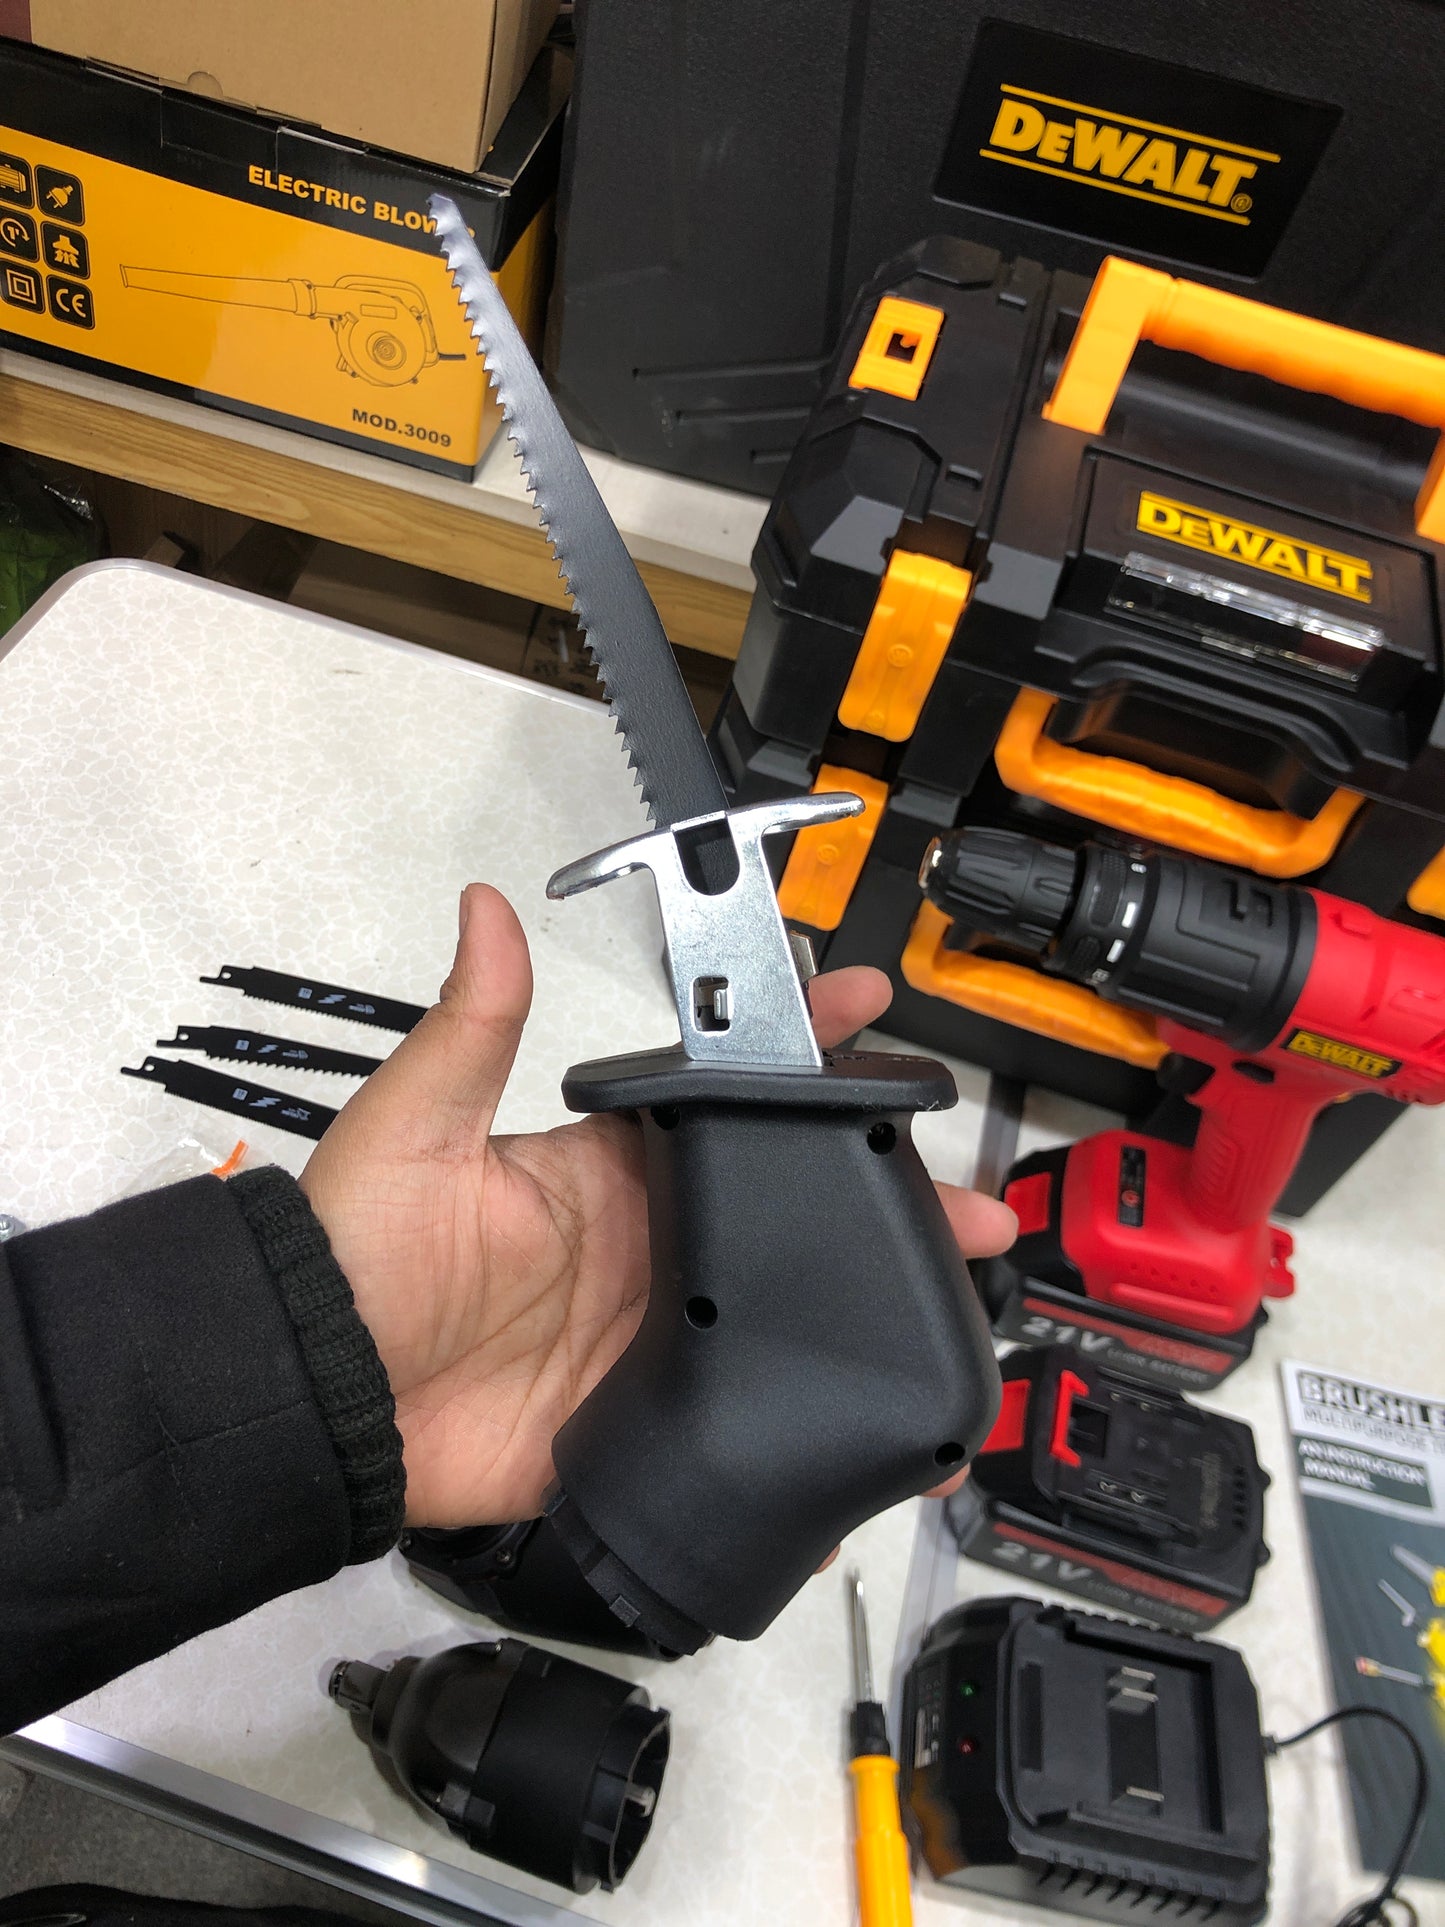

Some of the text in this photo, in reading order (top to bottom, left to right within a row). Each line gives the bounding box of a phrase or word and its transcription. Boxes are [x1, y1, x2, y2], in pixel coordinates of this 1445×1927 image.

[248, 164, 367, 215] ELECTRIC
[352, 408, 452, 447] MOD.3009
[1021, 1315, 1116, 1351] 21V
[992, 1540, 1094, 1581] 21V
